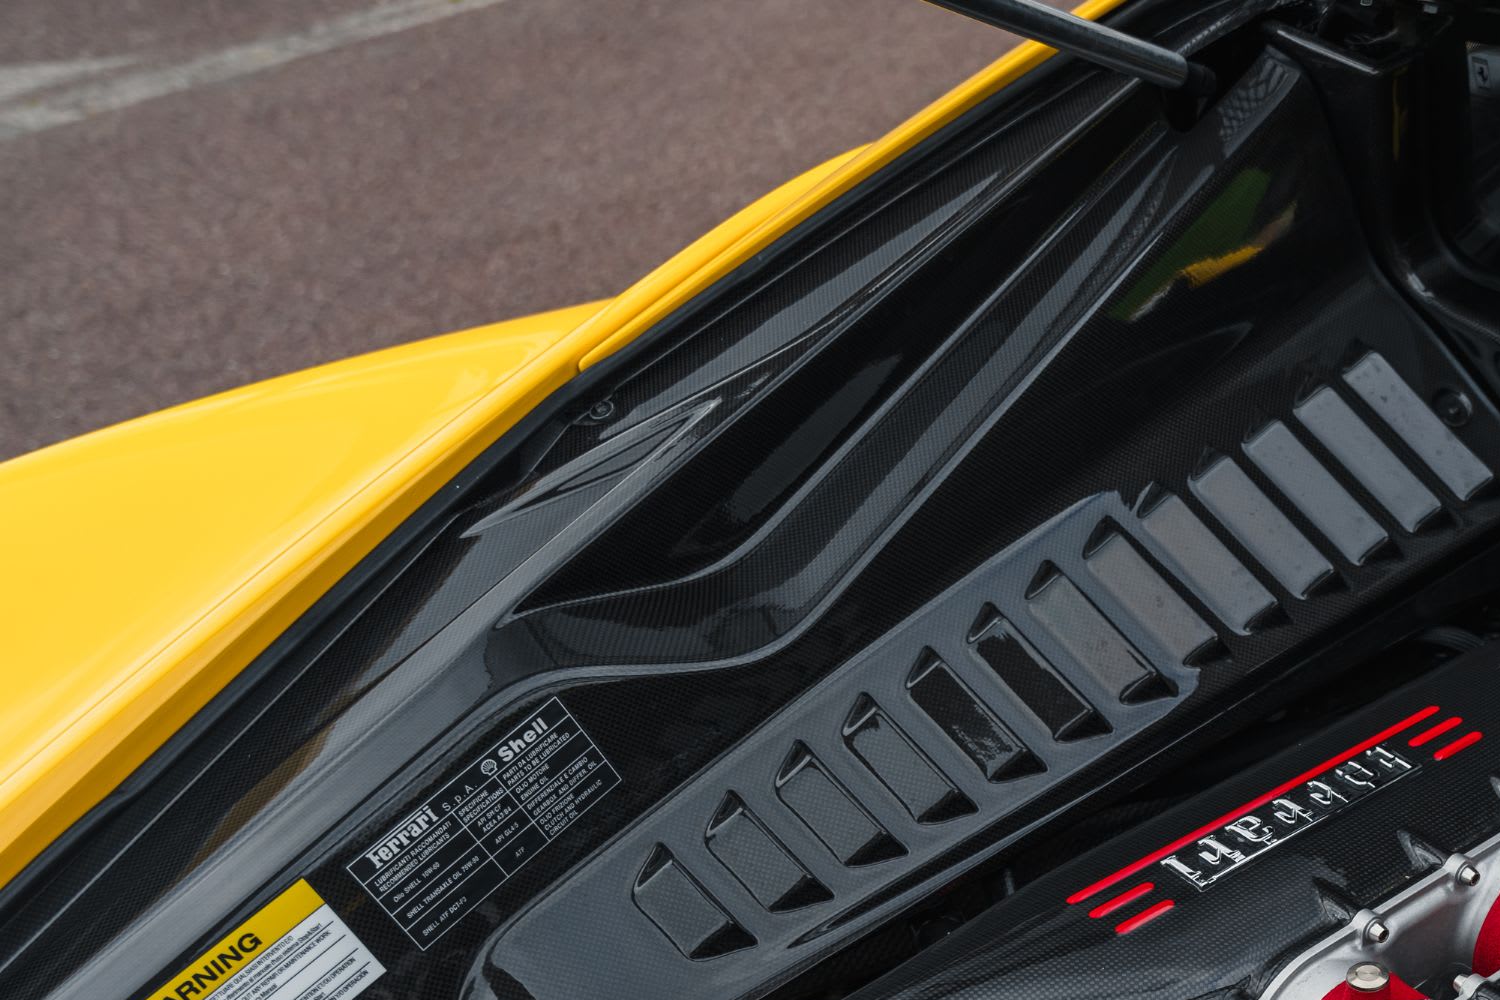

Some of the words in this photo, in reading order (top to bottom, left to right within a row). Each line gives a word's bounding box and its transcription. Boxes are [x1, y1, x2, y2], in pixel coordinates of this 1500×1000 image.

[497, 717, 549, 762] Shell
[501, 764, 519, 780] PARTI
[516, 758, 526, 768] DA
[524, 731, 559, 761] LUBRIFICARE
[506, 769, 525, 786] PARTS
[523, 763, 532, 772] TO
[530, 756, 540, 766] BE
[538, 731, 570, 759] LUBRICATED
[514, 780, 529, 794] OLIO
[527, 762, 550, 783] MOTORE
[519, 782, 540, 801] ENGINE
[538, 774, 549, 785] OIL
[526, 776, 565, 810] DIFFERENZIALE
[567, 755, 589, 775] CAMBIO
[532, 793, 558, 816] GEARBOX
[556, 783, 570, 795] AND
[586, 759, 597, 770] OIL
[457, 789, 489, 817] SPECIFICHE
[462, 786, 504, 823] SPECIFICATIONS
[481, 817, 497, 833] ACEA
[538, 811, 553, 825] OLIO
[550, 792, 575, 814] FRIZIONE
[543, 811, 565, 831] CLUTCH
[563, 802, 576, 814] AND
[573, 778, 603, 805] HYDRAULIC
[548, 816, 570, 835] CIRCUIT
[567, 808, 578, 819] OIL
[365, 805, 439, 869] Ferrari
[373, 853, 412, 887] LUBRIFICANTI
[409, 820, 452, 857] RACCOMANDATI
[378, 857, 419, 893] RECOMMENDED
[417, 831, 450, 861] LUBRICANTS
[402, 876, 422, 894] SHELL
[405, 902, 424, 919] SHELL
[422, 877, 453, 905] TRANSAXLE
[451, 869, 462, 880] OIL
[421, 919, 440, 936] SHELL
[437, 910, 451, 922] ATF
[250, 985, 262, 995] ANY
[283, 941, 317, 969] MAINTENANCE
